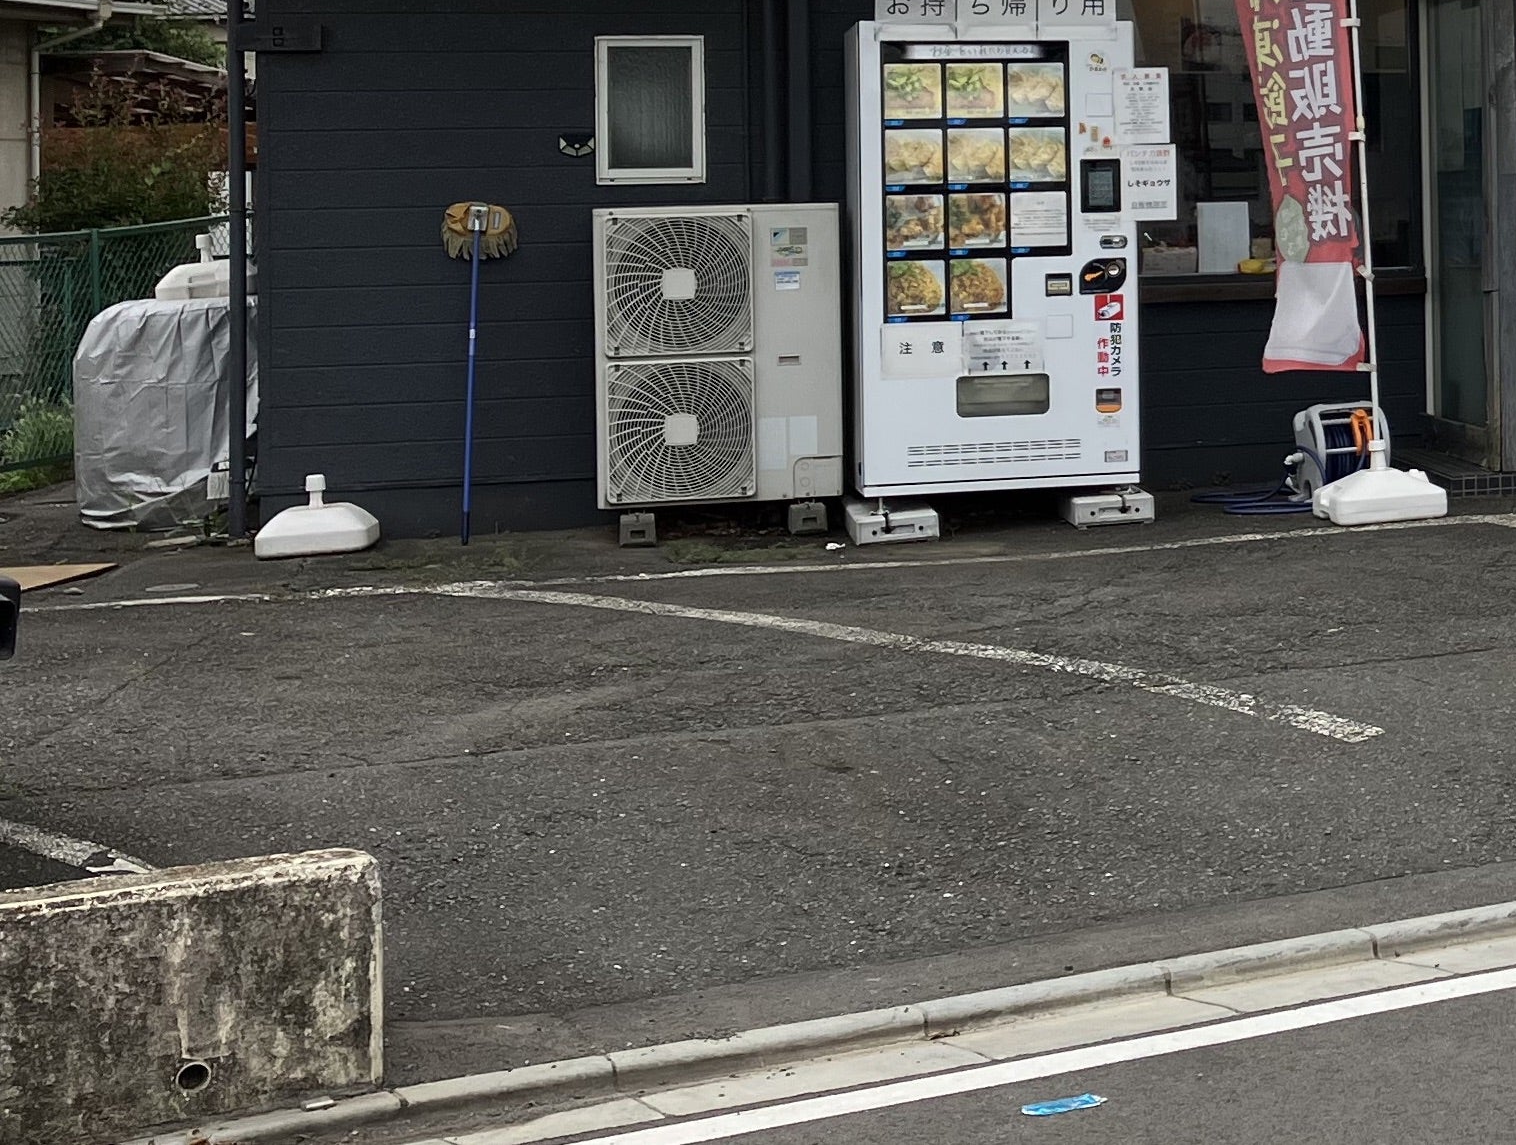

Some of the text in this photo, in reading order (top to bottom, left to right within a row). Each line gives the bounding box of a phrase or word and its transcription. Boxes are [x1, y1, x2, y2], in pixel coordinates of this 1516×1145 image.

[1127, 179, 1171, 188] しそギョウザ
[899, 340, 945, 355] 注意
[1097, 338, 1109, 376] 作動中
[1109, 322, 1122, 377] 防犯カメラ
